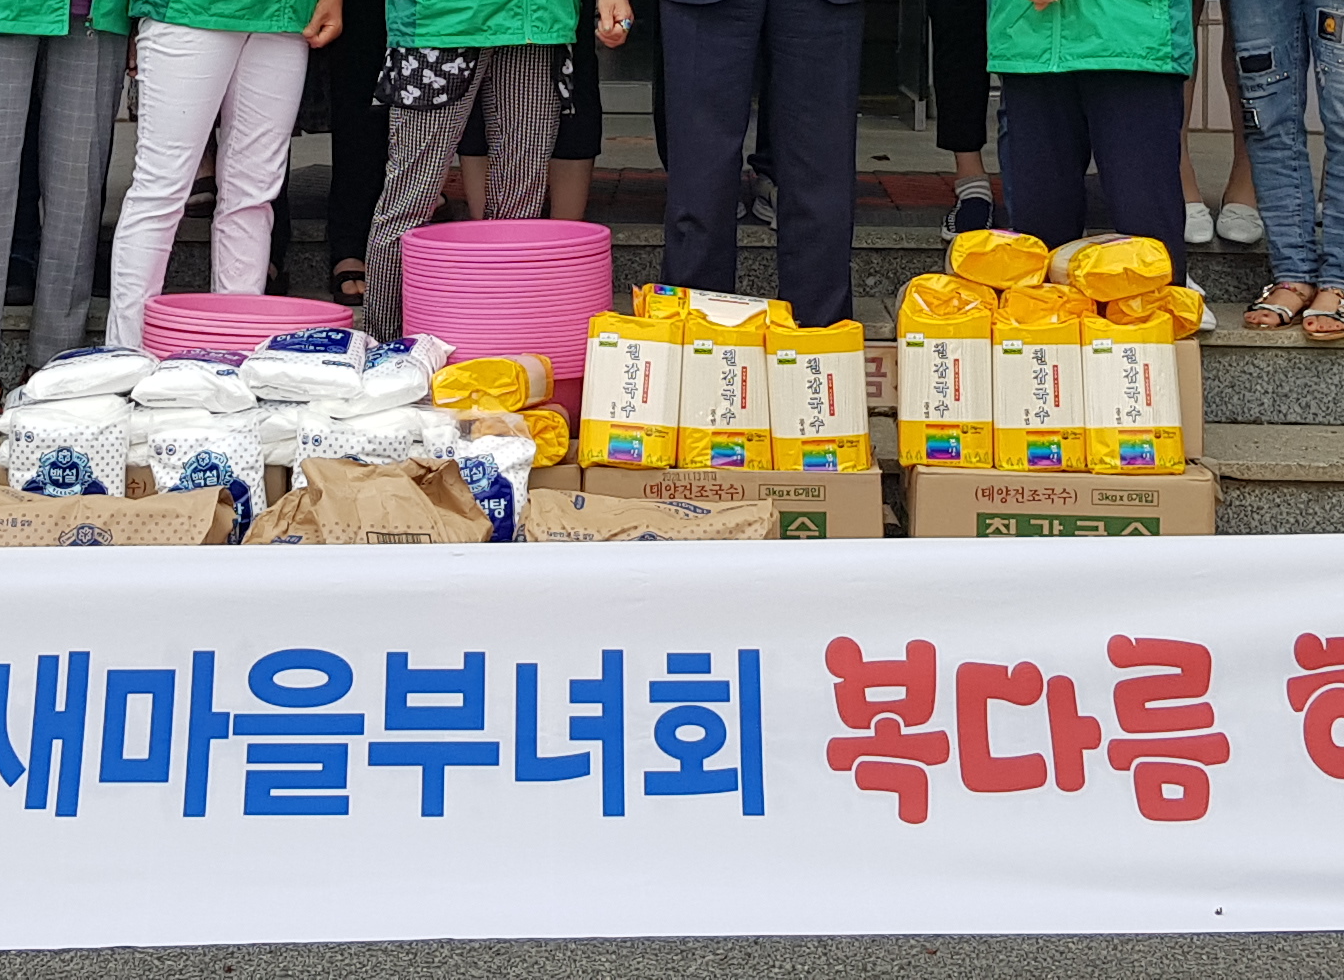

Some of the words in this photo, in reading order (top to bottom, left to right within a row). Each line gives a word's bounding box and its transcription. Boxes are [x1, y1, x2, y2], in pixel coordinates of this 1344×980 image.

[50, 468, 77, 484] 백설
[191, 469, 218, 487] 백설
[643, 482, 746, 501] (태양건조국수)
[765, 487, 784, 497] 3kg
[794, 486, 821, 498] 6개입
[974, 485, 1079, 506] (태양건조국수)
[1097, 491, 1116, 503] 3kg
[1127, 492, 1155, 504] 6개입
[823, 634, 1232, 826] 복다름
